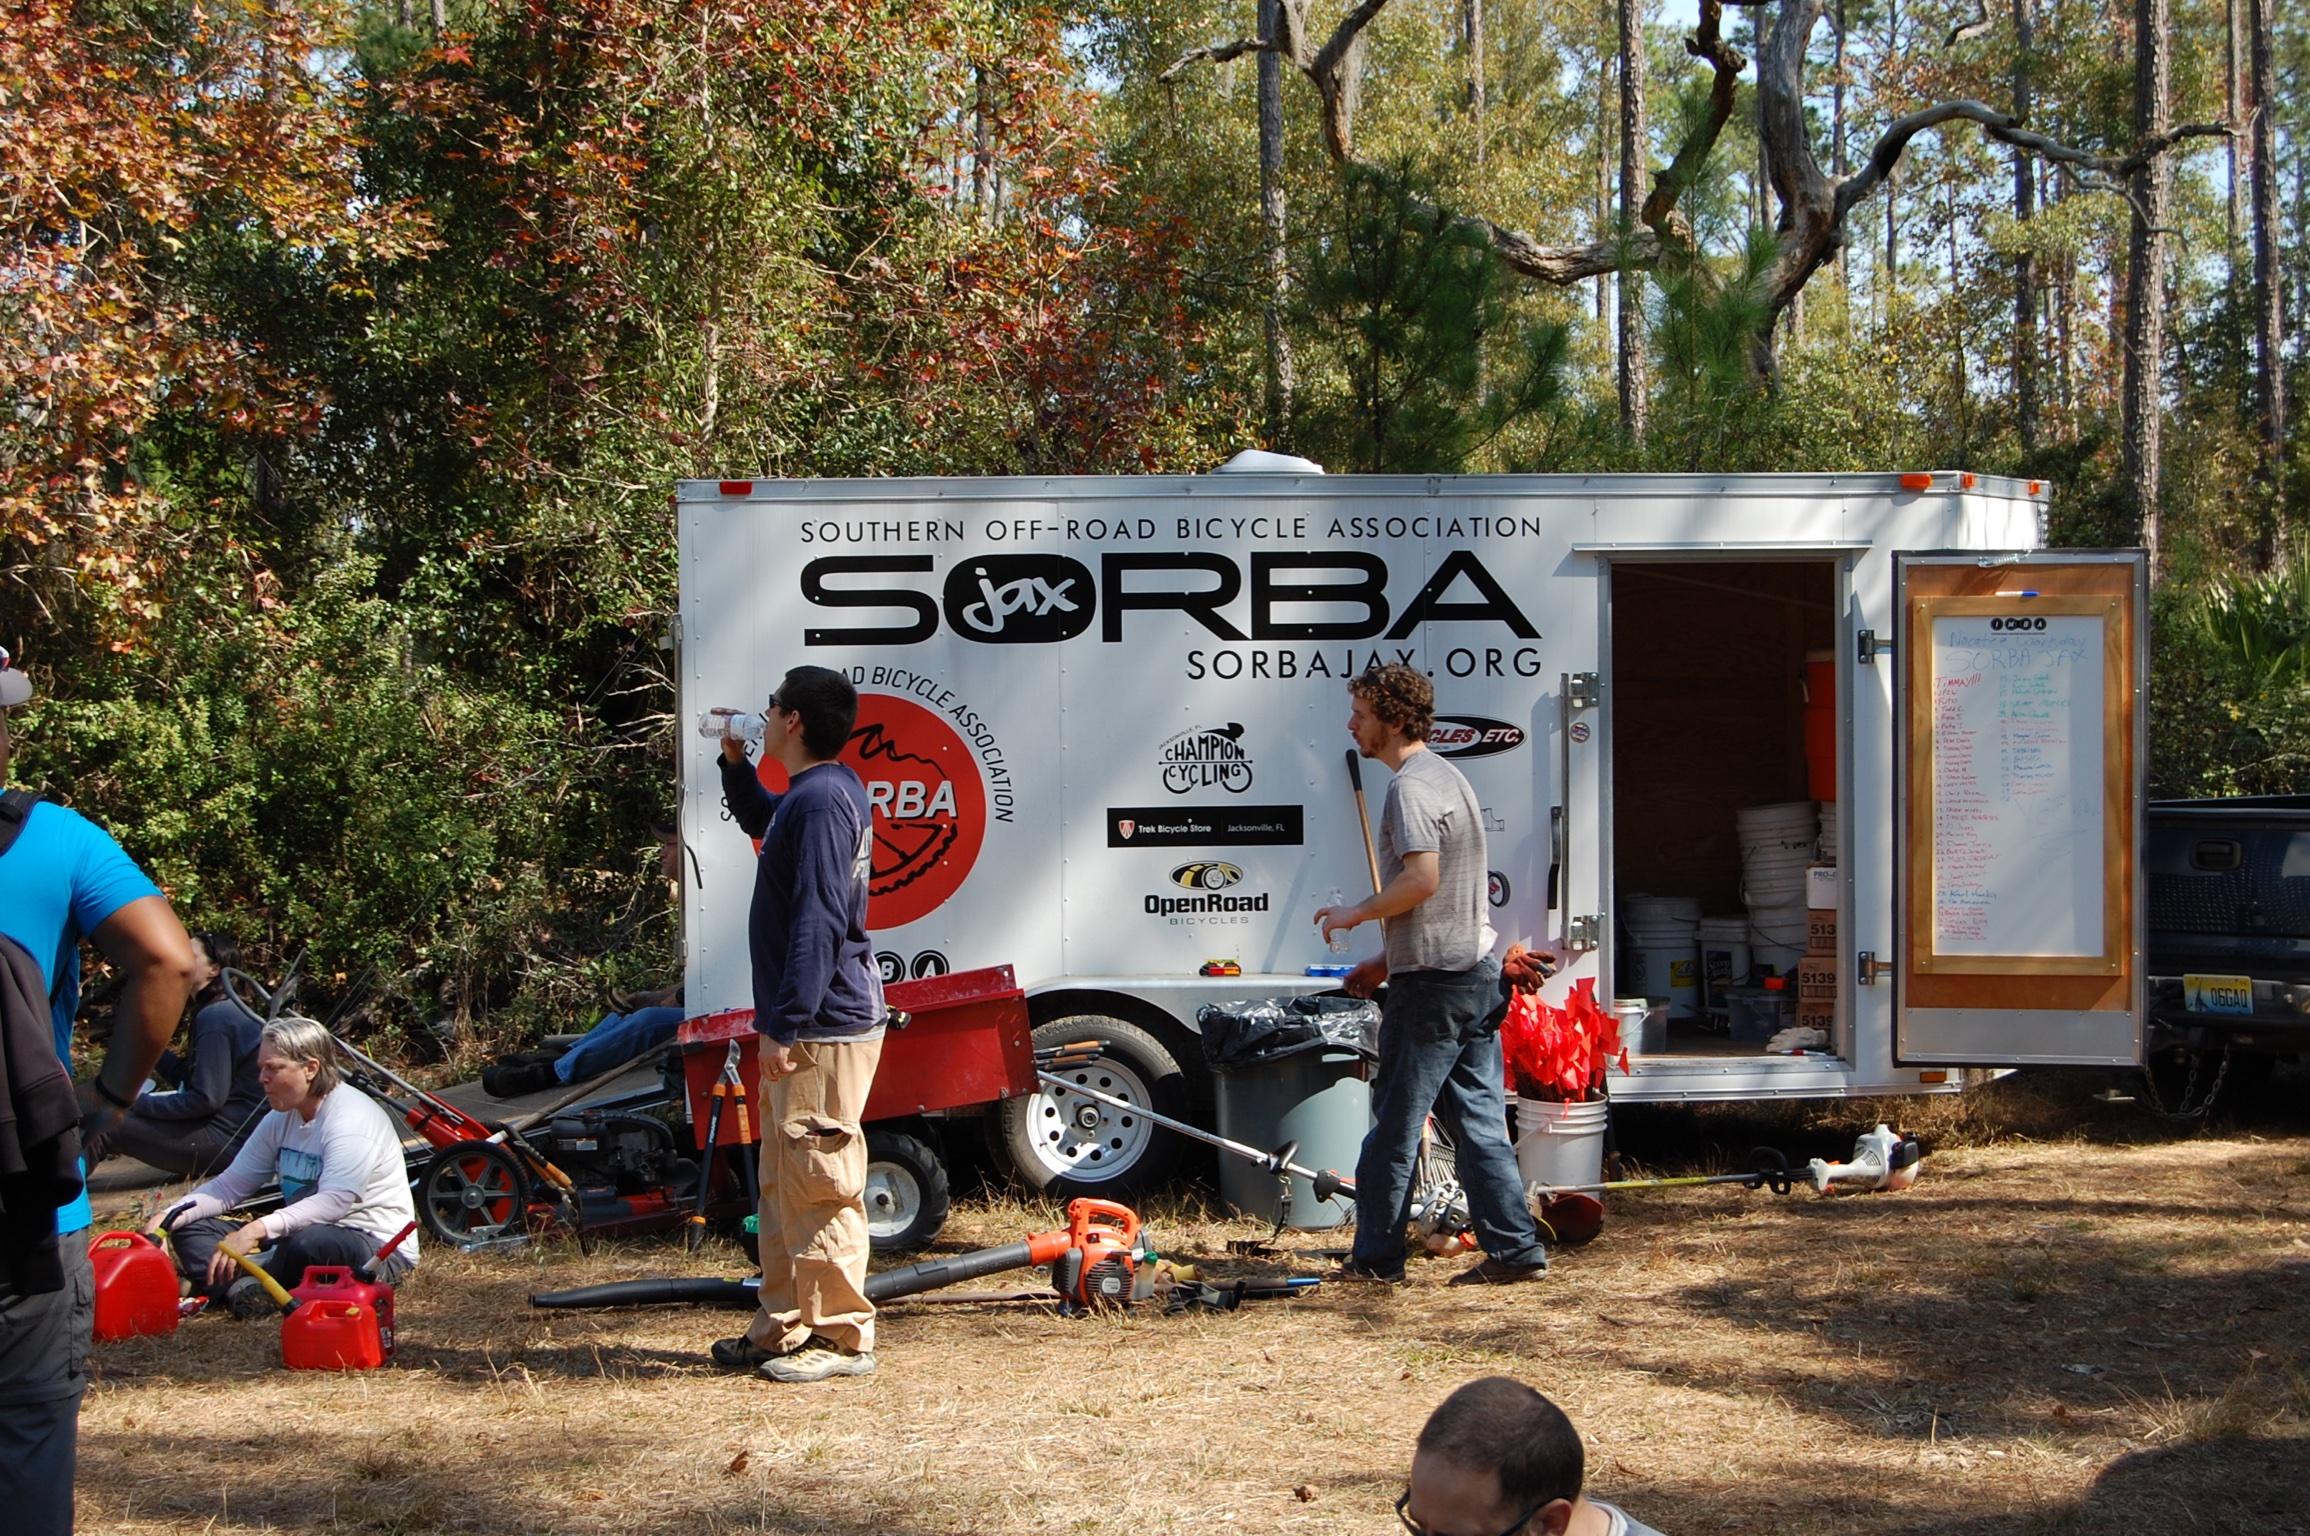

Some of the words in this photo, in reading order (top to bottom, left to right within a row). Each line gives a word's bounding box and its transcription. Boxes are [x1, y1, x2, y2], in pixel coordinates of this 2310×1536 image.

[802, 519, 964, 542] SOUTHERN
[986, 518, 1156, 541] OFF-ROAD
[1177, 518, 1305, 539] BICYCLE
[1327, 516, 1540, 539] ASSOCIATION
[800, 550, 1542, 646] SORBA
[961, 567, 1080, 634] jax
[1945, 648, 2031, 672] SORBA
[871, 666, 956, 708] BICYCLE
[948, 704, 1014, 823] ASSOCIATION
[1429, 729, 1476, 743] CLES
[1481, 728, 1520, 743] ETC.
[1165, 735, 1245, 761] CHAMPION
[1168, 764, 1242, 787] CYCLING
[1138, 824, 1157, 833] Trek
[1157, 824, 1188, 835] Bicycle
[1189, 824, 1212, 833] Store
[1227, 823, 1275, 833] Jacksonville,
[1275, 823, 1286, 832] FL
[1144, 893, 1269, 916] OpenRoad
[1169, 916, 1249, 926] BICYCLES
[1801, 972, 1837, 985] 5139
